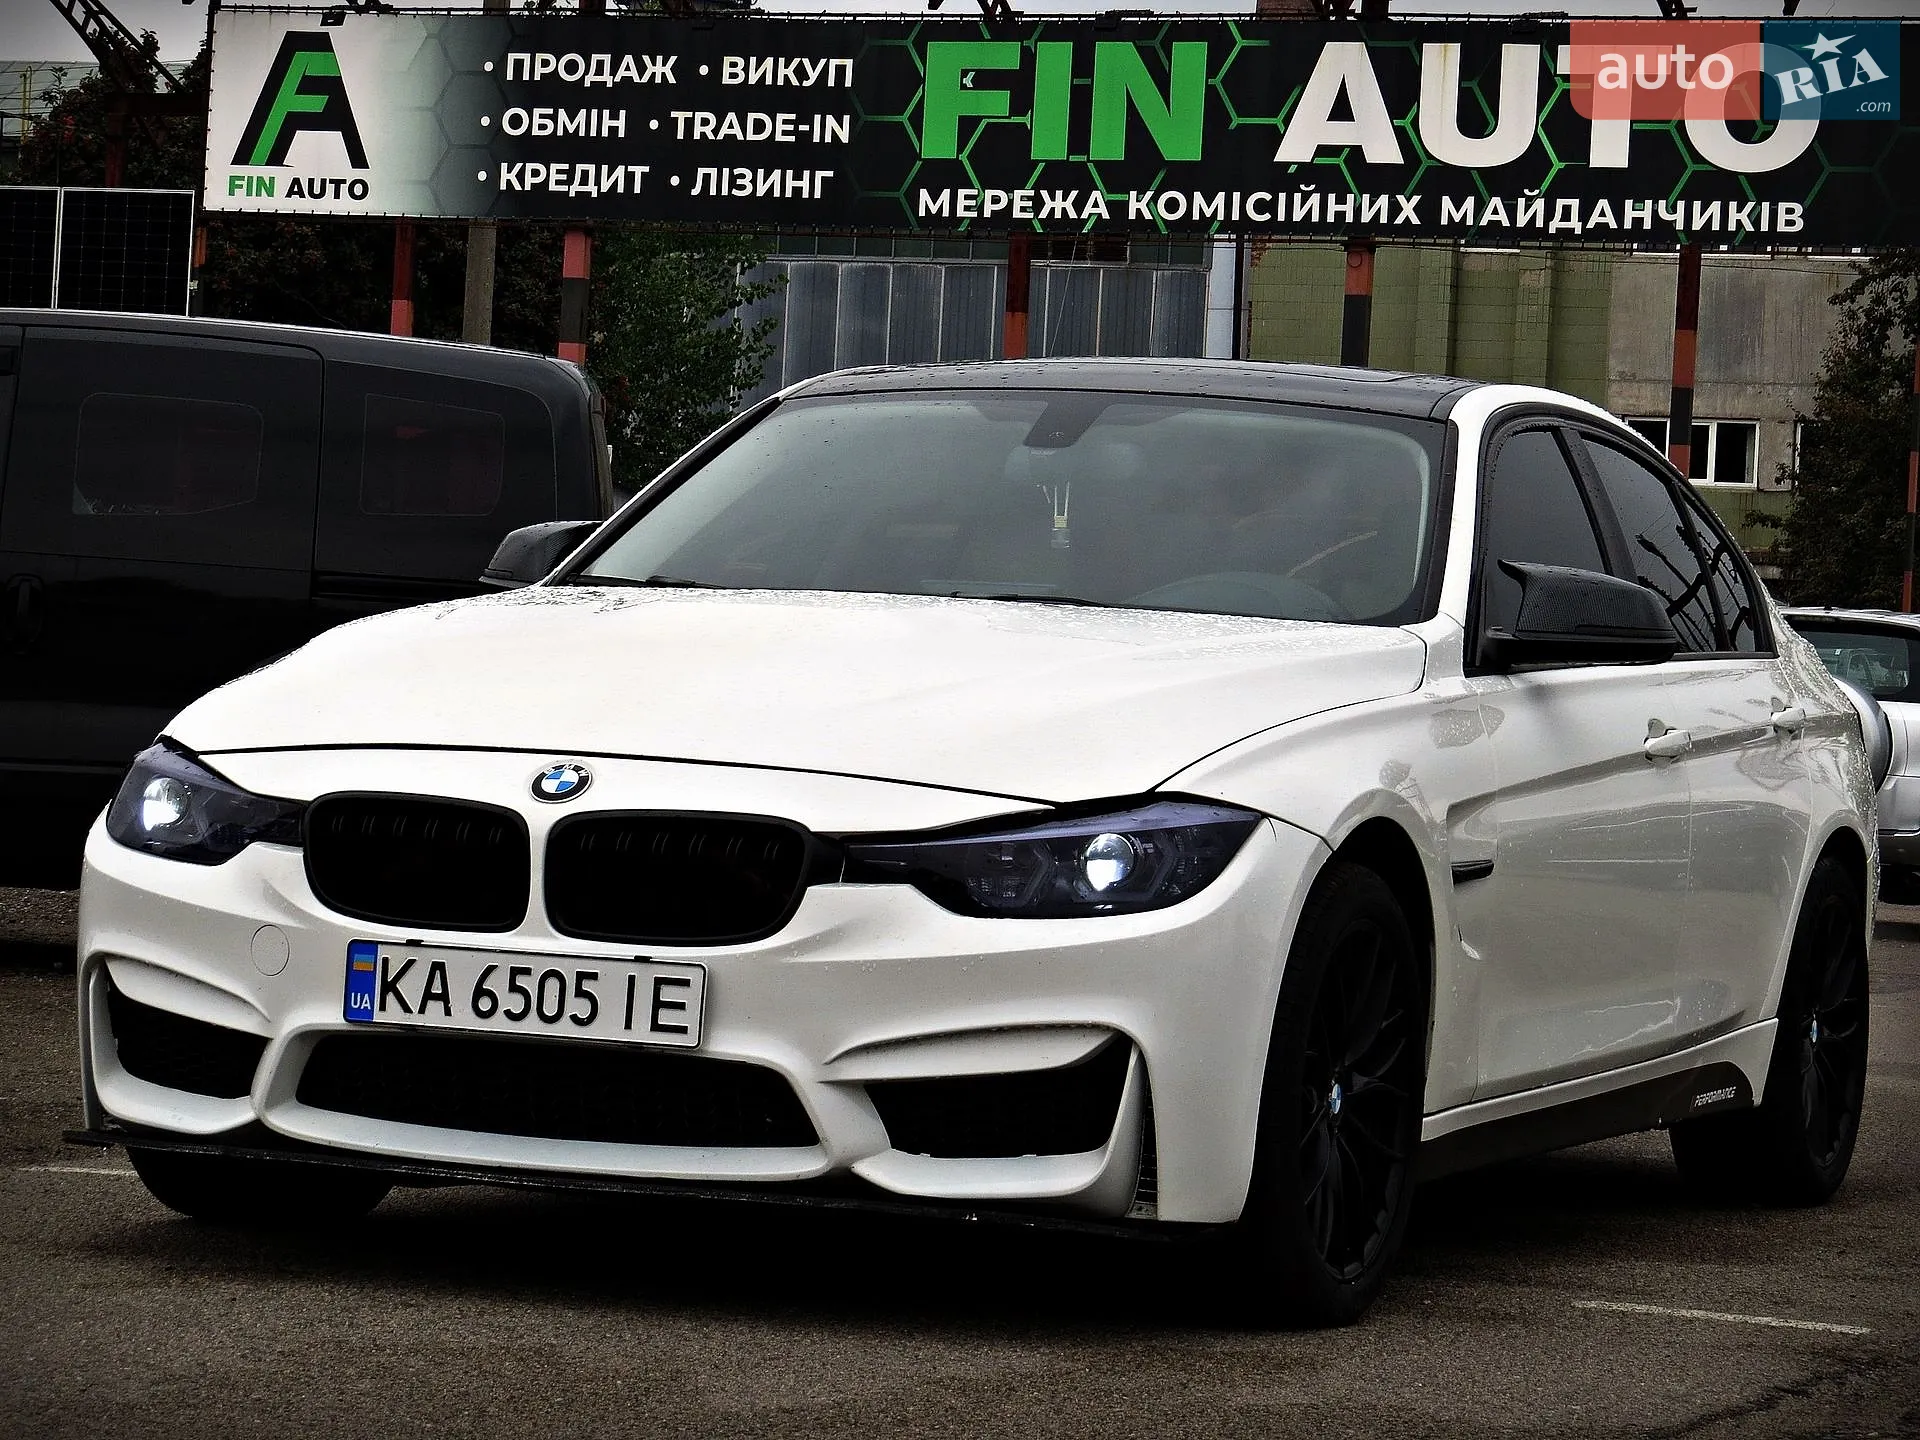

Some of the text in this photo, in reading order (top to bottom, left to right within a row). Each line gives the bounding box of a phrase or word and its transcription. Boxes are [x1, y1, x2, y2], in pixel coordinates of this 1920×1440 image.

[505, 53, 854, 88] ПРОДАЖ ВИКУП
[500, 107, 851, 144] ОБМІН TRADE-IN
[921, 41, 1821, 173] FIN AUTO
[228, 174, 370, 201] FIN AUTO
[499, 162, 835, 199] КРЕДИТ ЛІЗИНГ
[918, 184, 1805, 234] МЕРЕЖА КОМІСІЙНИХ МАЙДАНЧИКІВ
[351, 992, 371, 1010] UA
[378, 957, 692, 1035] KA 6505 IE
